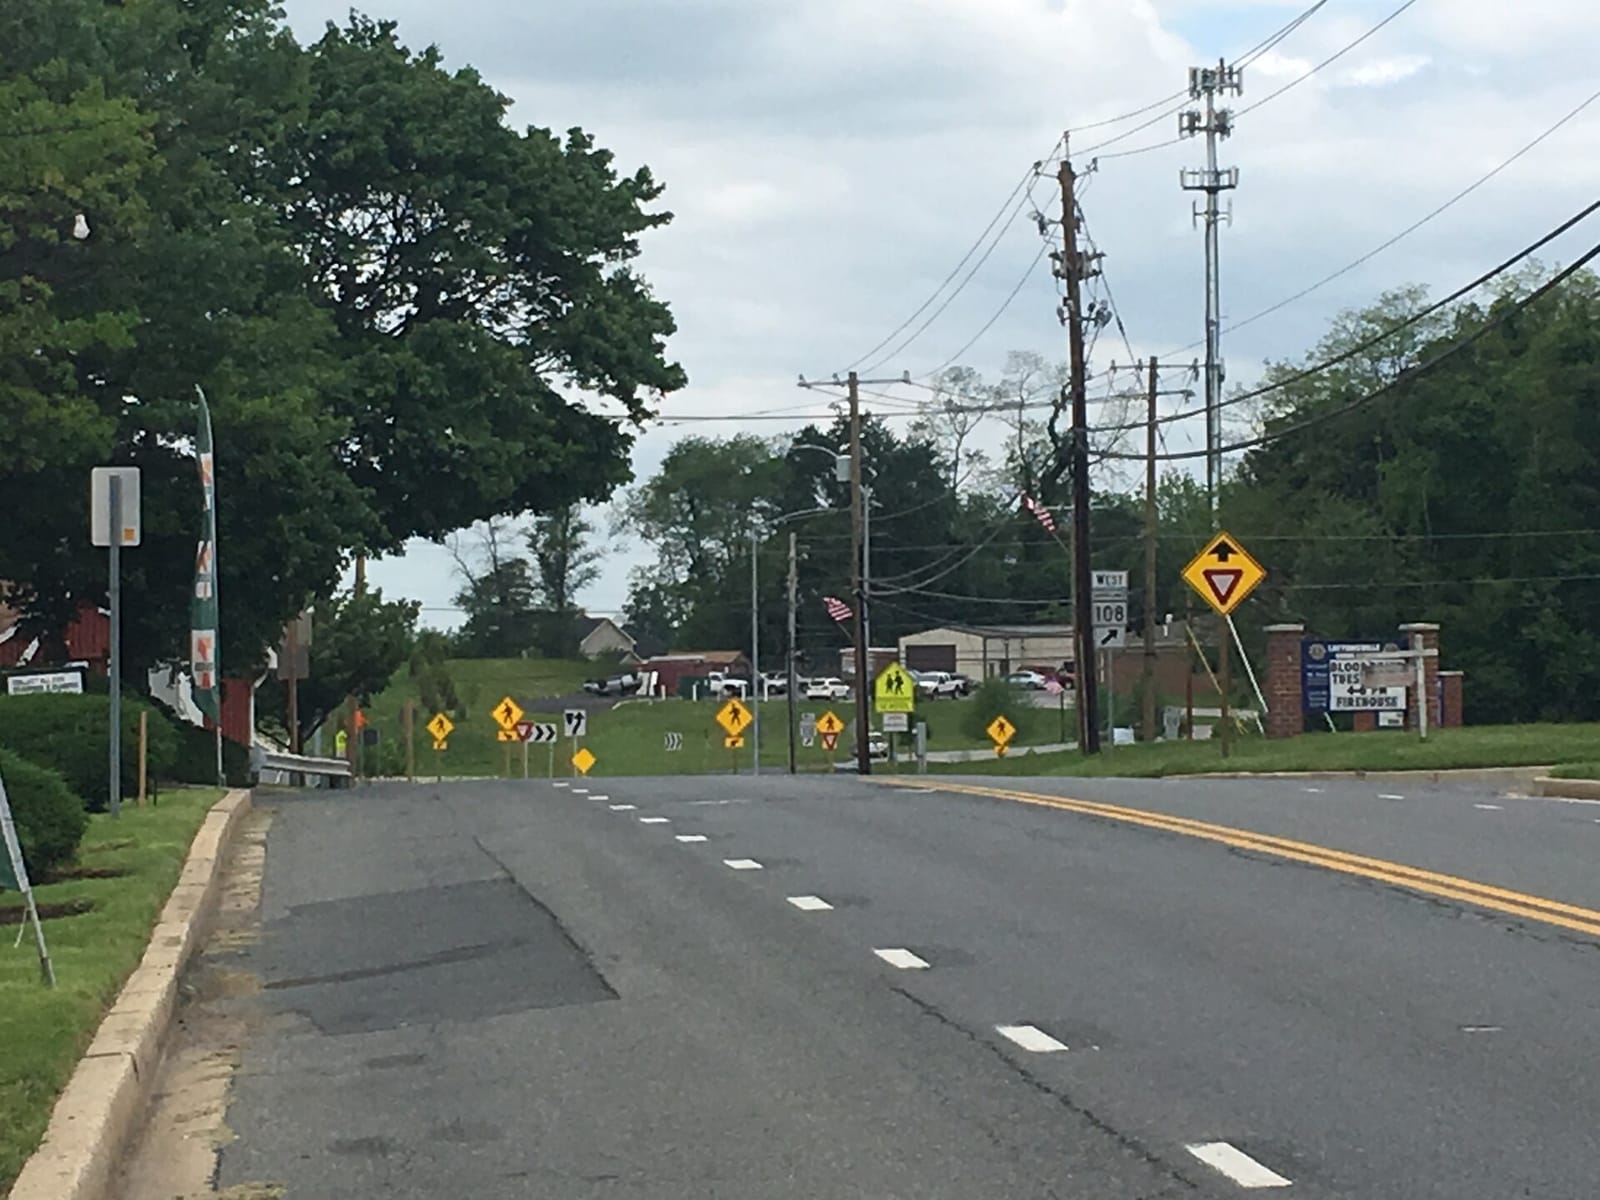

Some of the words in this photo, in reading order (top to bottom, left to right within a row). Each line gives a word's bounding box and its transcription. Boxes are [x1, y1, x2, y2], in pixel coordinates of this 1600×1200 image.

[1096, 574, 1123, 586] WEST
[1096, 604, 1124, 622] 108
[1336, 696, 1398, 708] FIREHOUSE
